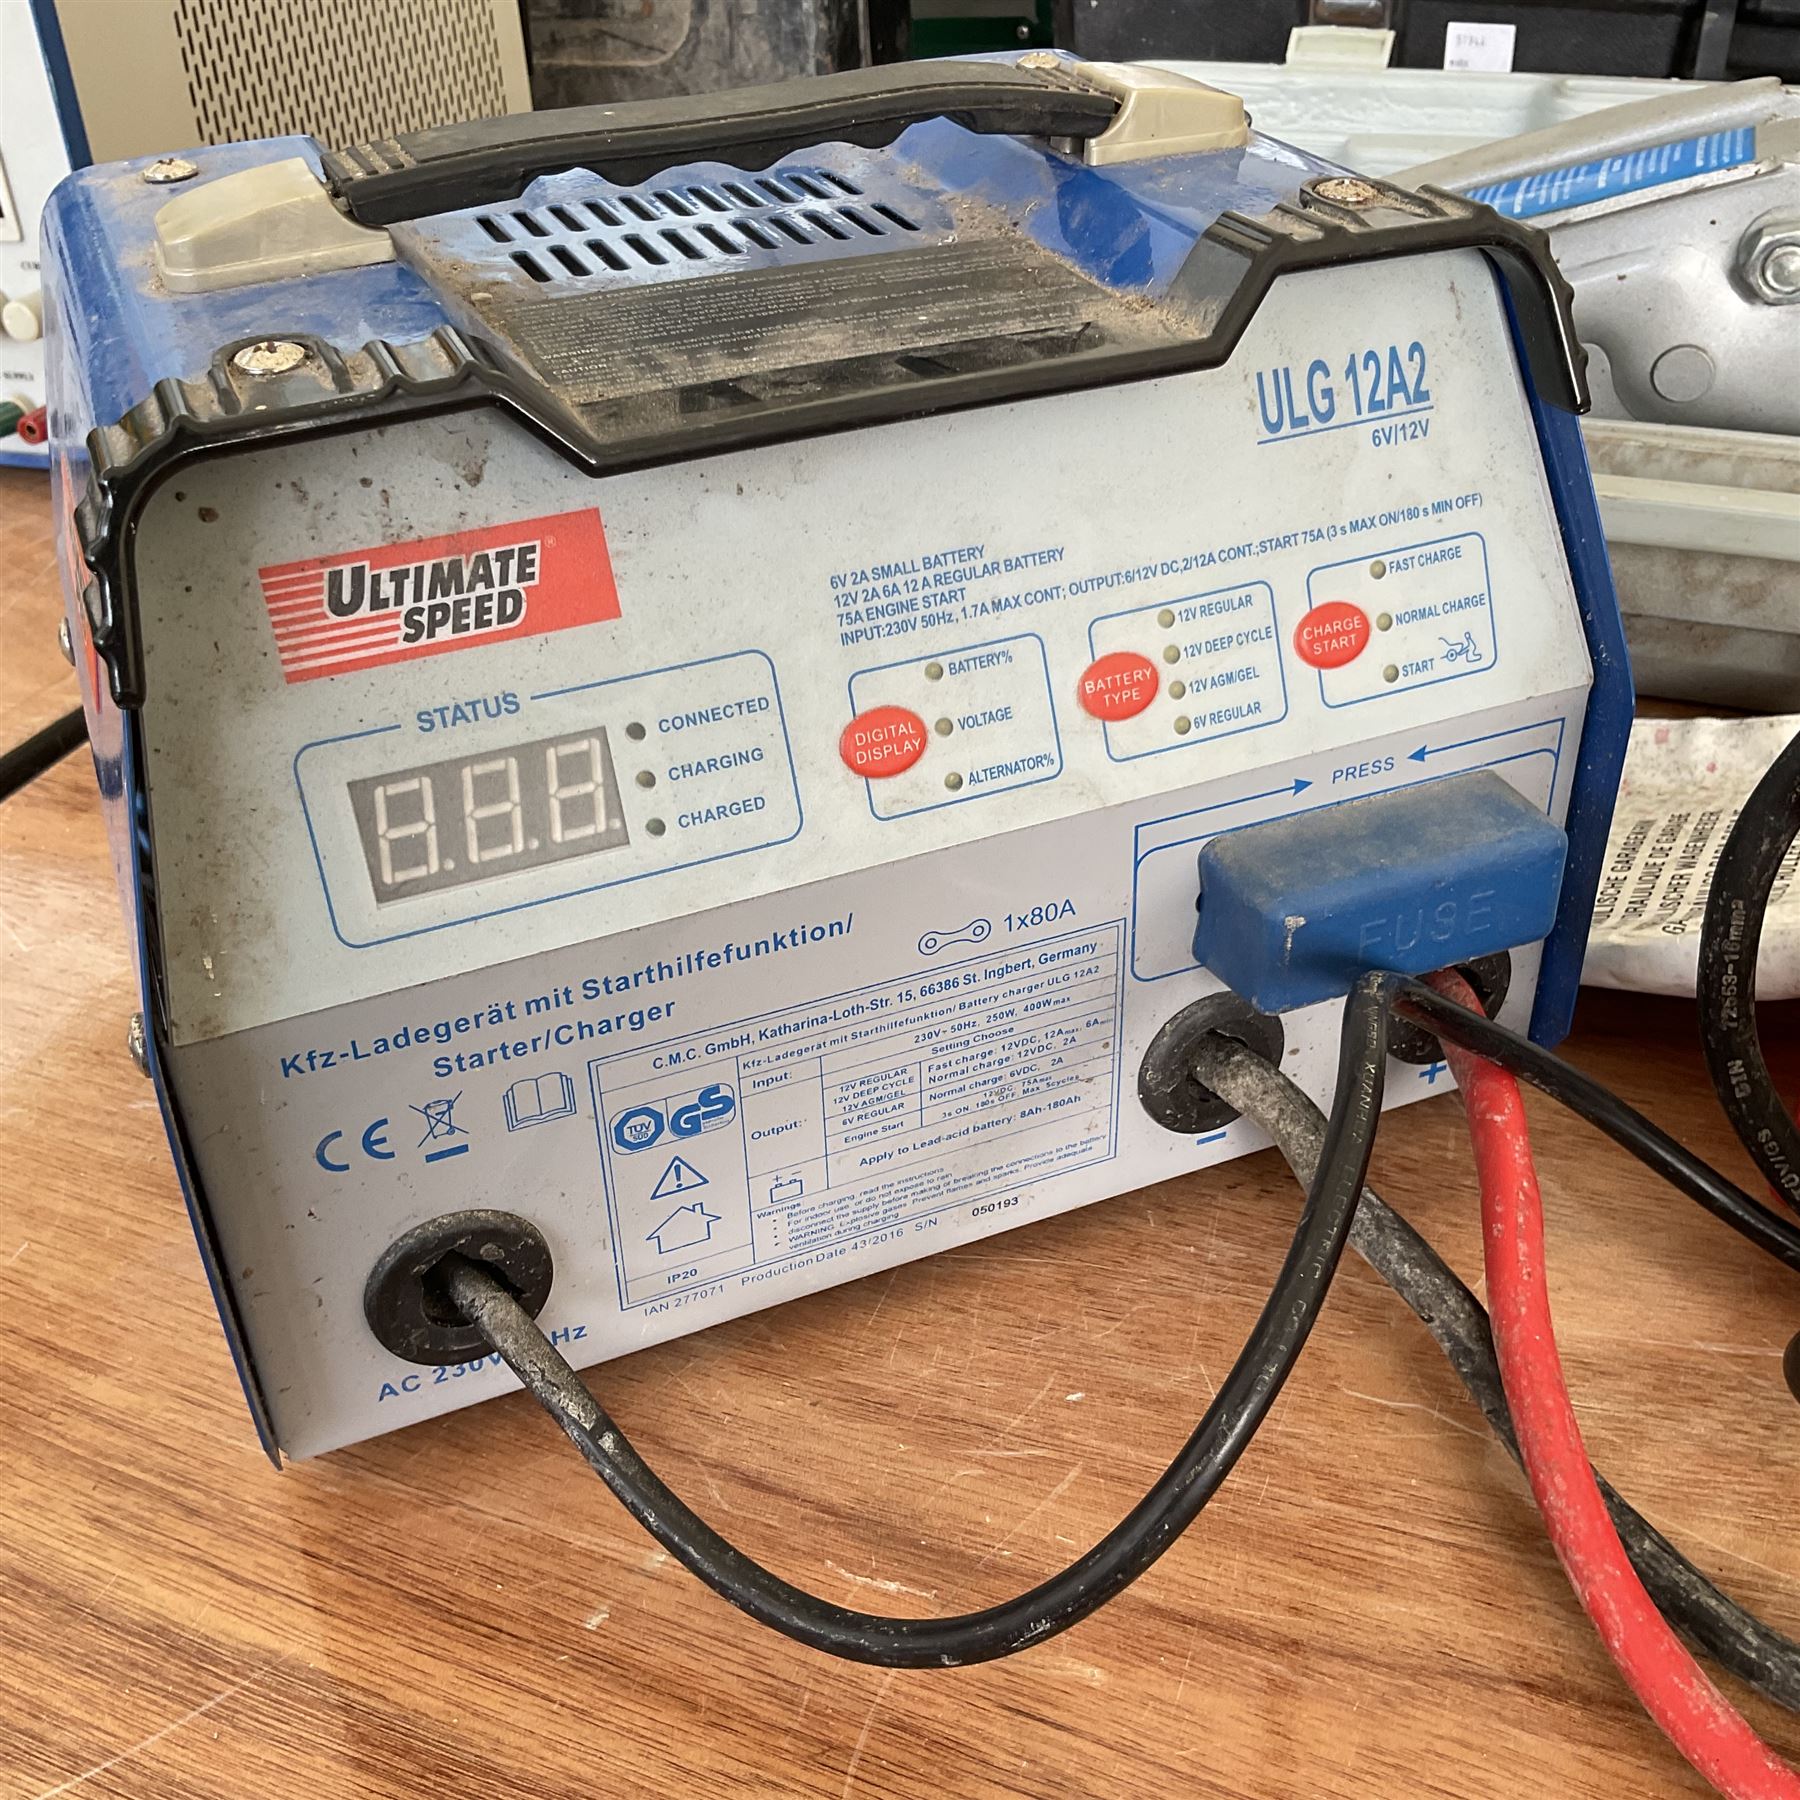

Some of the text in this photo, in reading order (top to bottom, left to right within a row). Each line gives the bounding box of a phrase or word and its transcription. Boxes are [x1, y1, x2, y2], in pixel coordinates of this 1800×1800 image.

[1256, 341, 1430, 434] ULG 12A2
[1372, 418, 1429, 447] 6V/12V
[830, 545, 984, 589] 6V 2A SMALL BATTERY
[841, 619, 917, 646] INPUT:230V
[961, 602, 990, 620] 1.7A
[992, 596, 1022, 614] MAX
[1024, 586, 1066, 605] CONT;
[1069, 564, 1158, 595] OUTPUT:6/12V
[1161, 552, 1216, 576] DC,2/12A
[1301, 529, 1325, 544] 75A
[1326, 525, 1338, 542] (3
[1340, 526, 1347, 536] s
[1350, 516, 1377, 533] MAX
[1379, 506, 1420, 527] ON/180
[1423, 508, 1429, 517] s
[1432, 500, 1453, 515] MIN
[1455, 492, 1483, 509] OFF)
[1389, 545, 1462, 574] FAST CHARGE
[328, 544, 537, 618] ULTIMATE
[834, 593, 858, 608] 12V
[862, 587, 881, 603] 2A
[882, 583, 901, 598] 6A
[933, 562, 1000, 587] REGULAR
[1004, 547, 1064, 572] BATTERY
[402, 588, 525, 643] SPEED
[837, 588, 966, 627] 75A ENGINE START
[1178, 594, 1253, 623] 12V REGULAR
[1395, 593, 1486, 626] NORMAL CHARGE
[1184, 625, 1272, 658] 12V DEEP CYCLE
[1303, 616, 1363, 640] CHARGE
[1313, 634, 1357, 655] START
[948, 650, 1013, 676] BATTERY%
[1402, 658, 1435, 677] START
[1084, 668, 1151, 694] BATTERY
[1189, 666, 1260, 694] 12V AGM/GEL
[416, 691, 521, 733] STATUS
[1104, 688, 1141, 707] TYPE
[658, 696, 770, 733] CONNECTED
[958, 706, 1012, 730] VOLTAGE
[1194, 701, 1261, 729] 6V REGULAR
[855, 721, 917, 746] DIGITAL
[668, 746, 764, 781] CHARGING
[856, 738, 921, 765] DISPLAY
[968, 752, 1054, 785] ALTERNATOR%
[1332, 756, 1396, 785] PRESS
[677, 795, 766, 830] CHARGED
[1004, 899, 1076, 932] 1x80A
[1360, 890, 1495, 962] FUSE
[280, 912, 853, 1078] Kfz-Ladegerät mit Starthilfefunktion/
[652, 942, 1097, 1070] C.M.C. GmbH, Katharina-Loth-Str. 15, 66386 St. Ingbert, Germany
[829, 1034, 848, 1047] mit
[959, 993, 999, 1011] Battery
[1002, 981, 1044, 998] charger
[1047, 974, 1070, 987] ULG
[1074, 965, 1100, 978] 12A2
[433, 1001, 675, 1078] Starter/Charger
[931, 1026, 1015, 1055] Setting Choose
[928, 1068, 970, 1084] Normal
[1063, 1036, 1077, 1046] 2A
[928, 1060, 952, 1073] Fast
[752, 1071, 792, 1089] Input:
[833, 1076, 915, 1105] 12V DEEP CYCLE
[839, 1068, 908, 1093] 12V REGULAR
[929, 1084, 967, 1101] Normal
[1050, 1056, 1064, 1066] 2A
[671, 1083, 735, 1136] GS
[842, 1089, 907, 1112] 12V AGM/GEL
[842, 1102, 905, 1126] 6V REGULAR
[751, 1120, 802, 1140] Output:
[844, 1121, 904, 1144] Engine Start
[859, 1095, 1081, 1167] Apply to Lead-acid battery: 8Ah-180Ah
[741, 1197, 1019, 1286] Production Date 43/2016 S/N 050193
[667, 1268, 698, 1284] IP20
[644, 1285, 724, 1317] IAN 277071
[378, 1375, 421, 1402] AC
